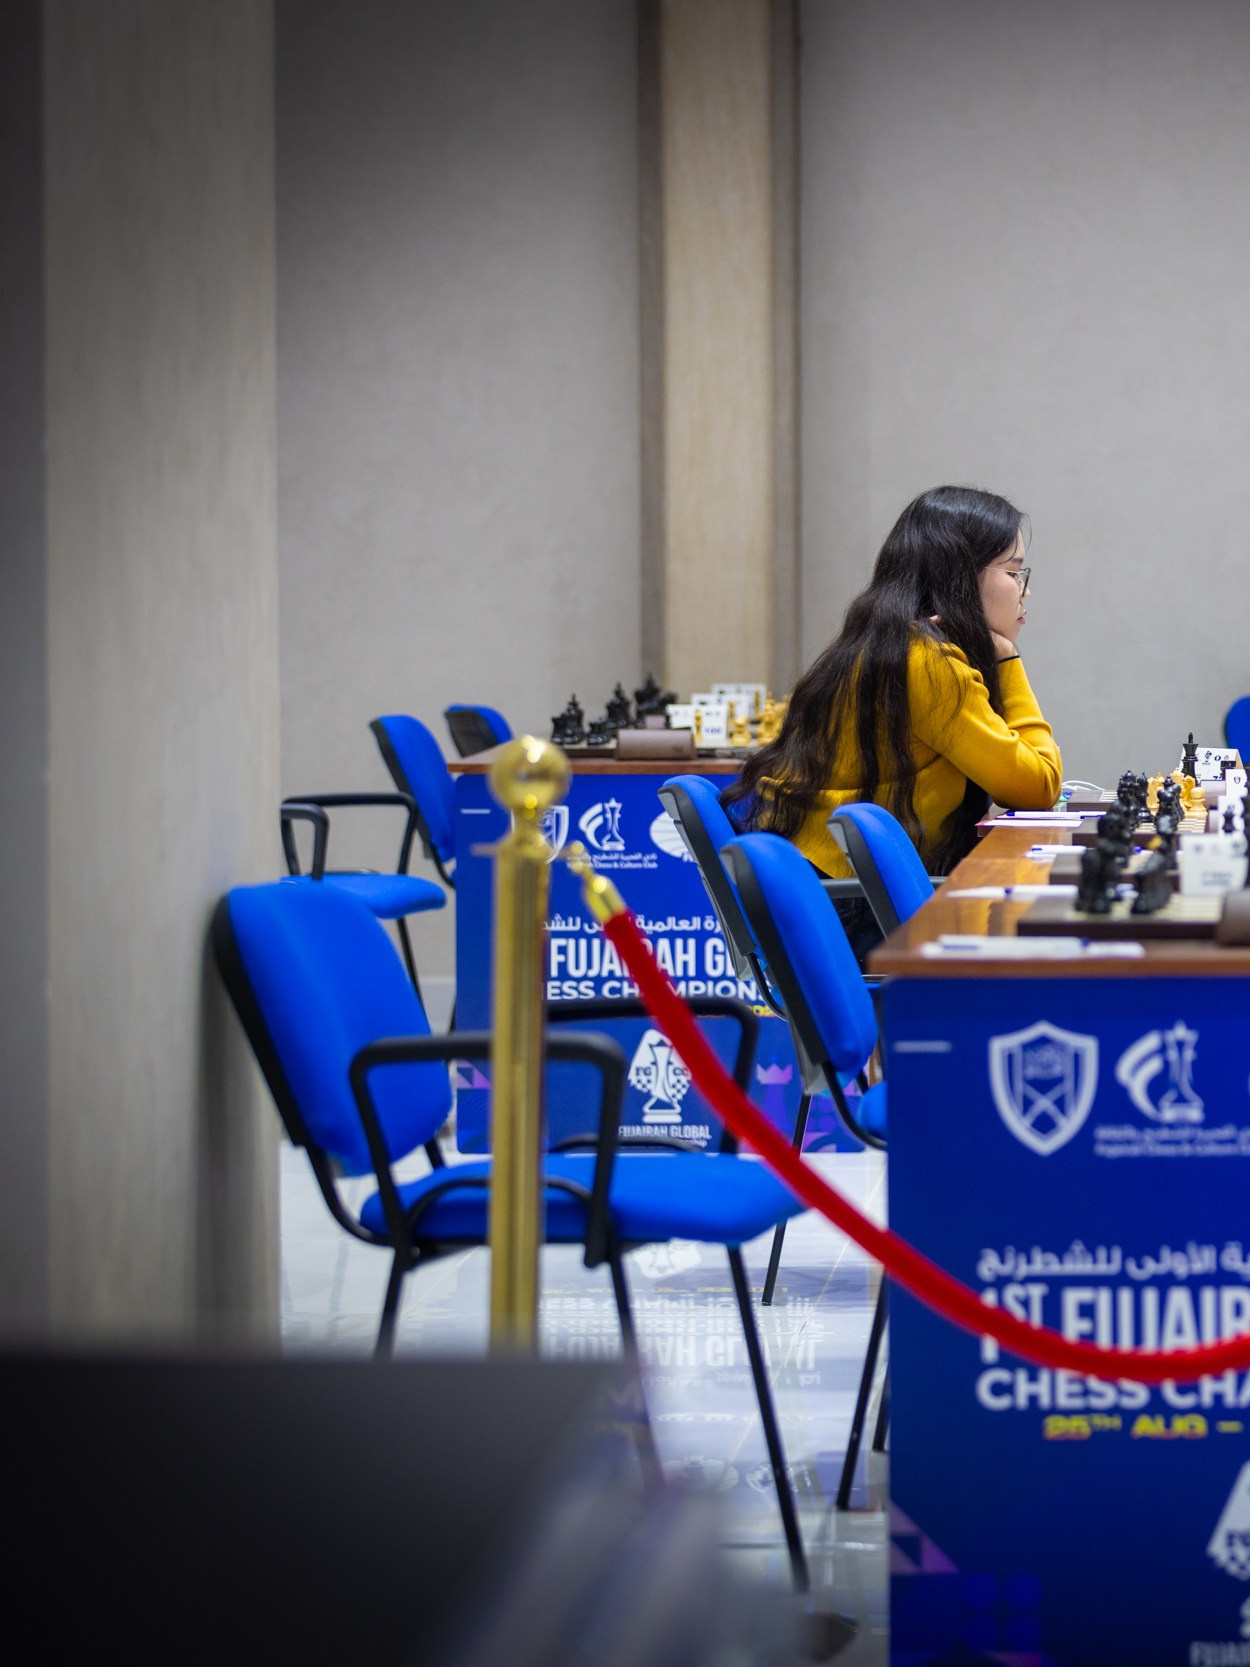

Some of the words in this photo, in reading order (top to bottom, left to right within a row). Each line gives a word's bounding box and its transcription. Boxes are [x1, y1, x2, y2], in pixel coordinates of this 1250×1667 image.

[550, 937, 697, 978] FUJAAH
[546, 980, 596, 1001] ESS
[669, 1125, 711, 1140] GLOBAL
[976, 1366, 1151, 1411] CHESS
